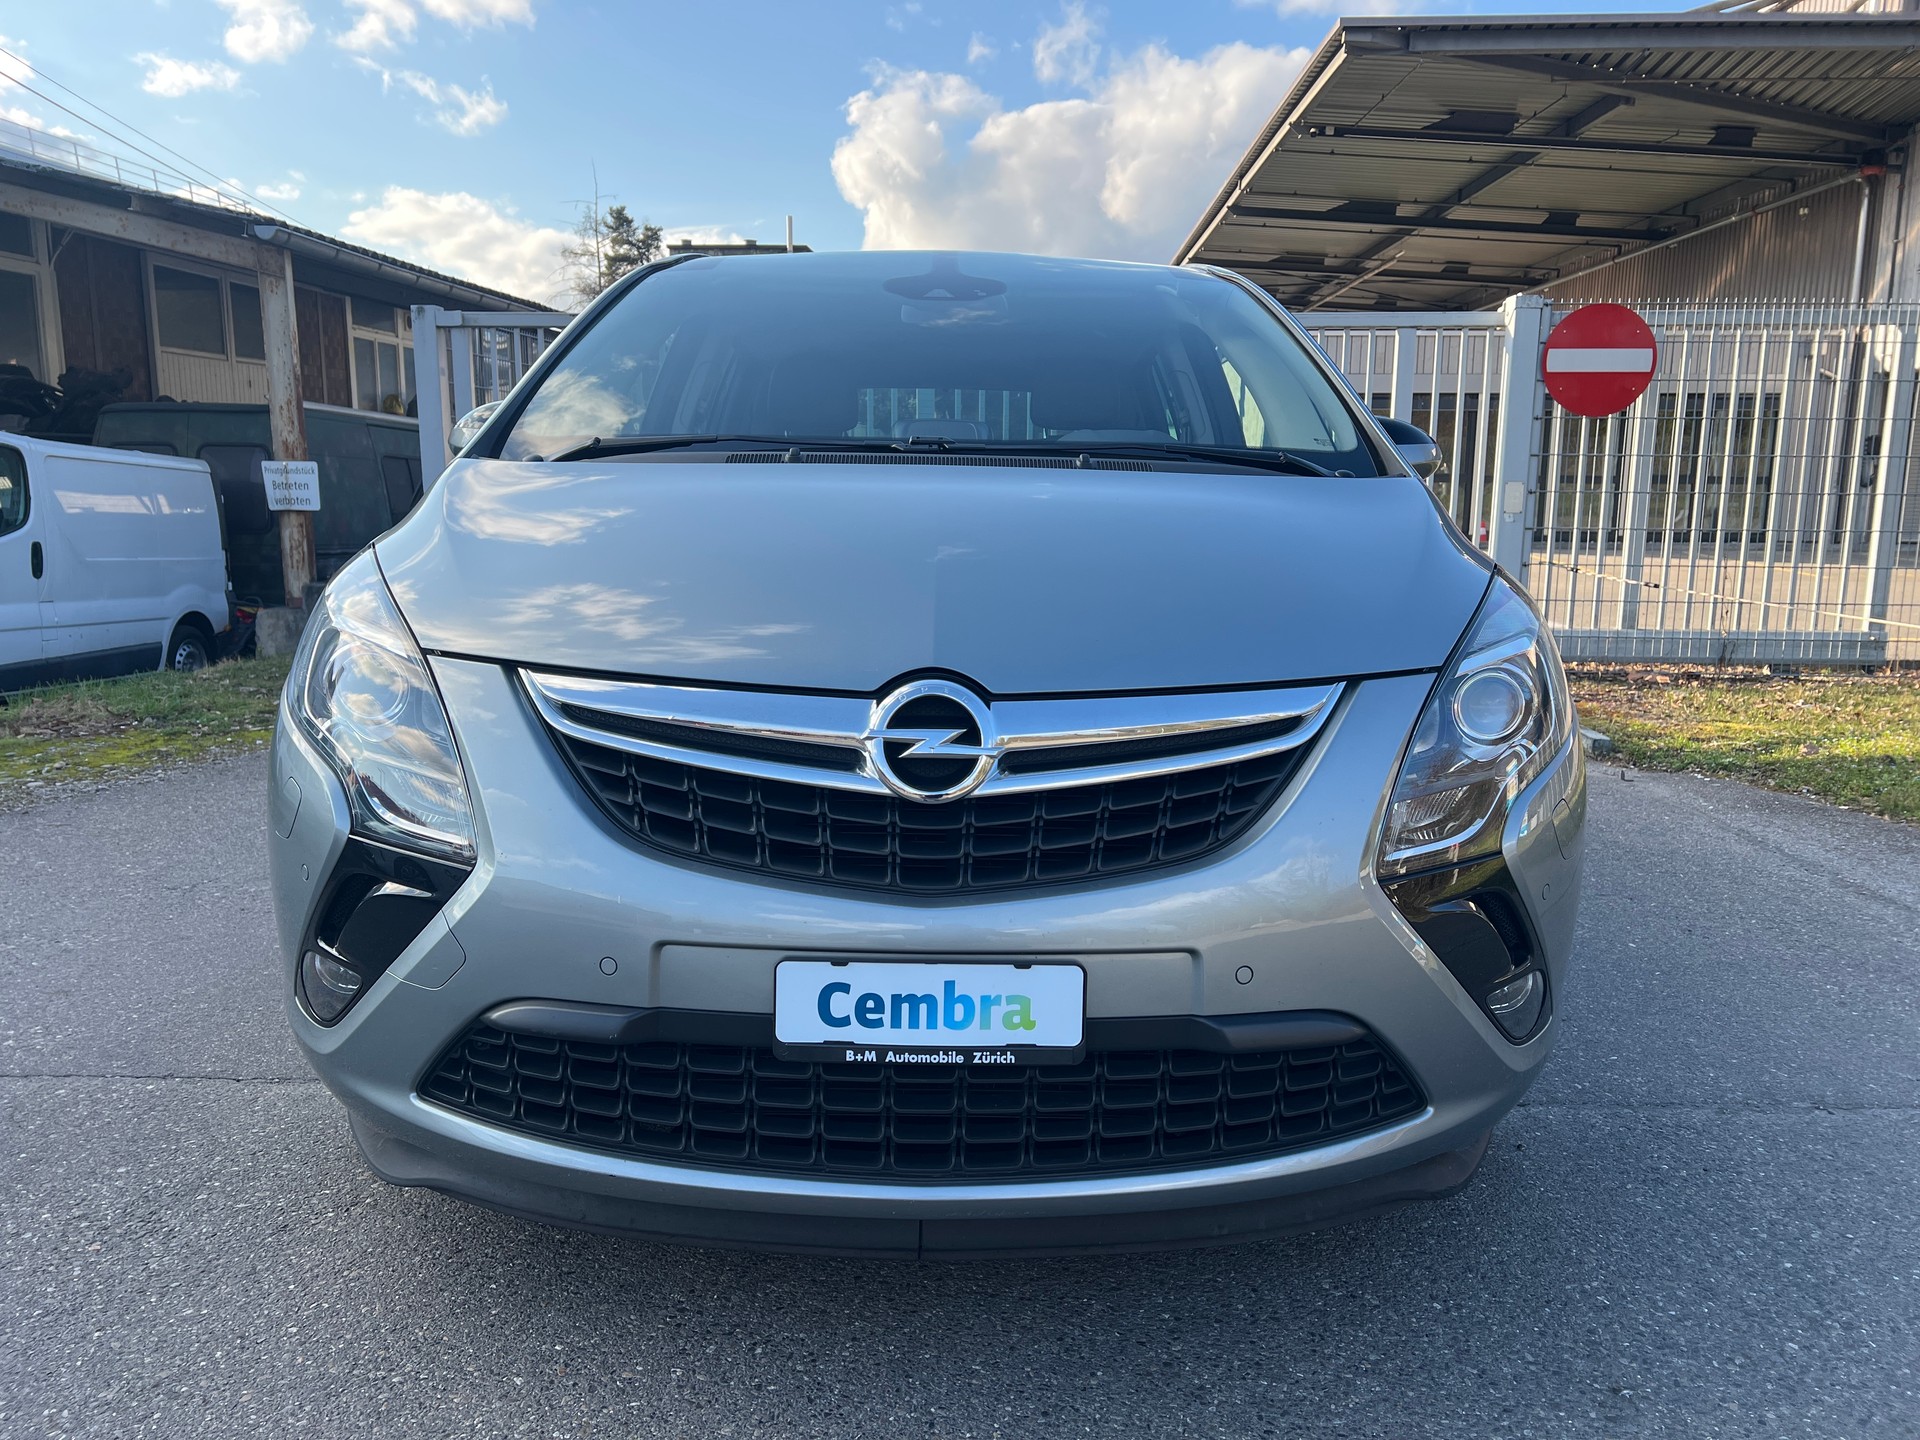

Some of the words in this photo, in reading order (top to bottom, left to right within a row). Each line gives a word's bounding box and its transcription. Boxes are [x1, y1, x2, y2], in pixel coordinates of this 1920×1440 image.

[271, 480, 309, 491] Betreten
[273, 495, 311, 506] verboten
[816, 979, 1037, 1031] Cembra
[845, 1050, 877, 1062] B+M
[885, 1051, 964, 1064] Automobile
[972, 1051, 1015, 1064] Zürich
